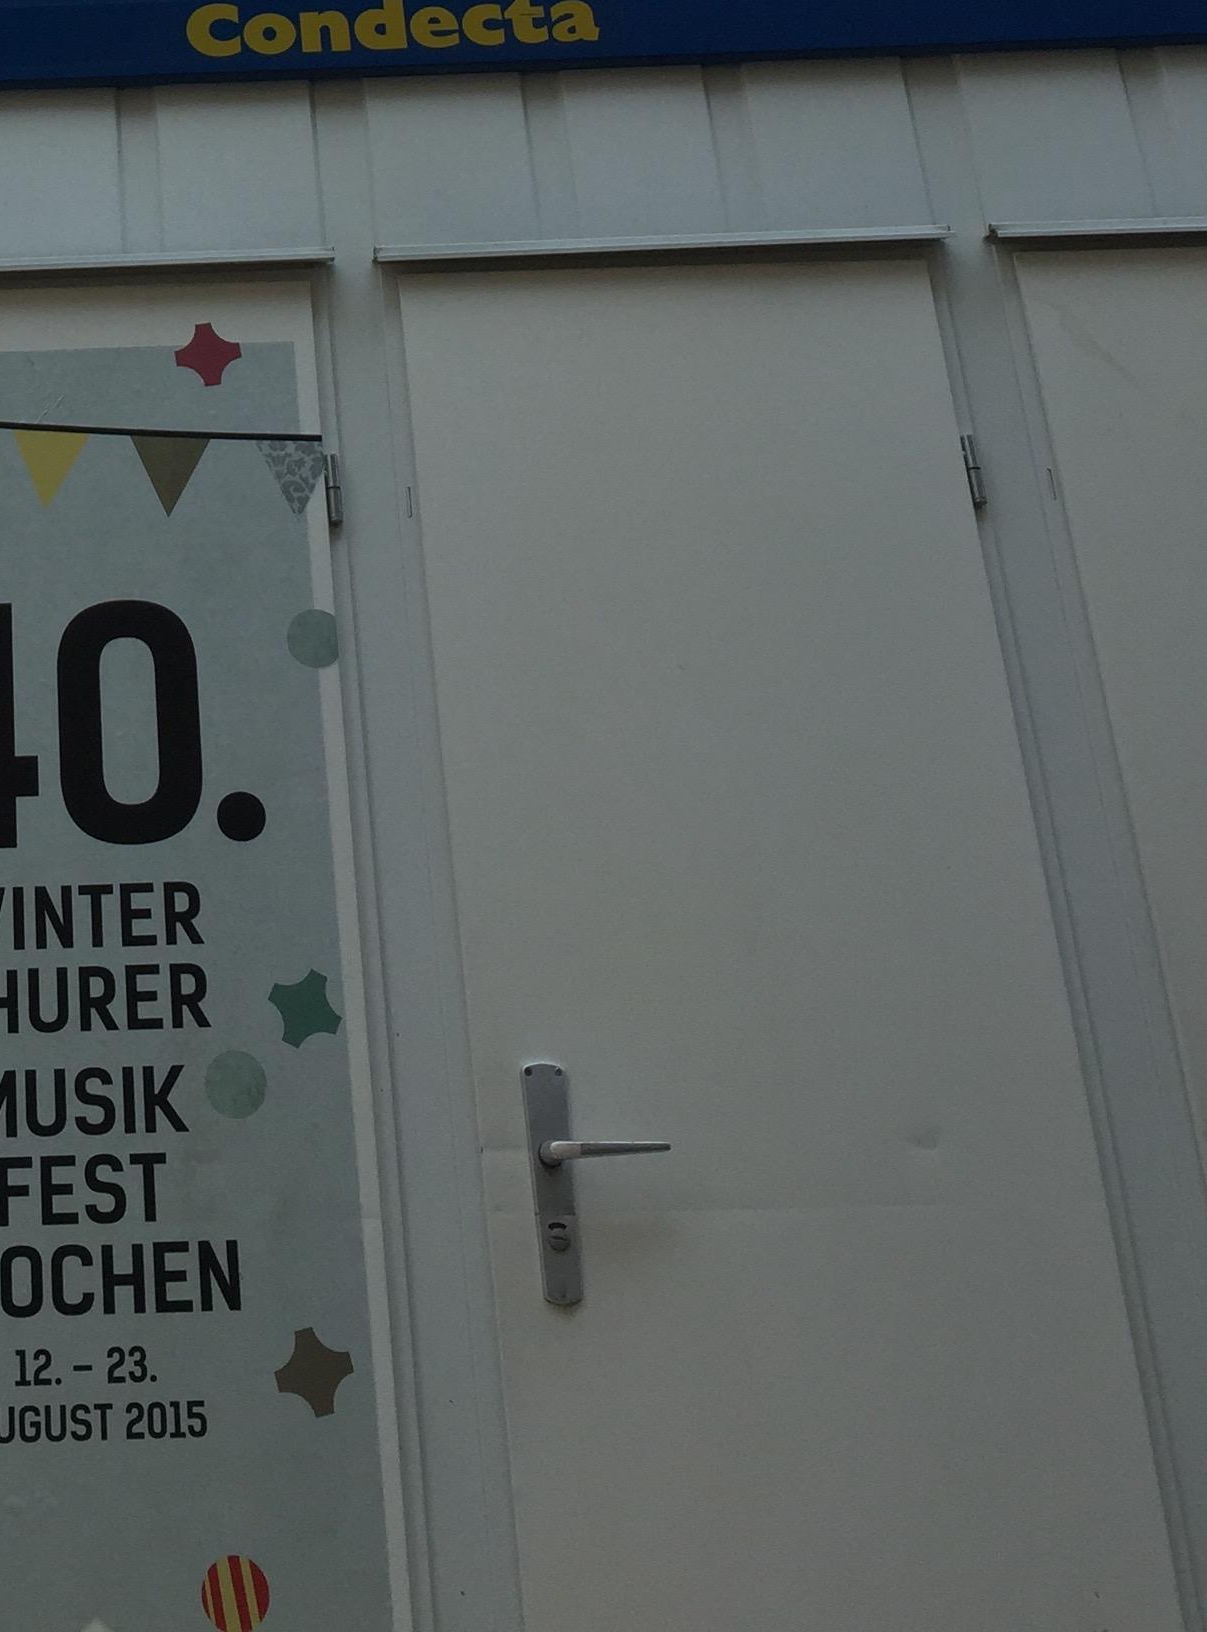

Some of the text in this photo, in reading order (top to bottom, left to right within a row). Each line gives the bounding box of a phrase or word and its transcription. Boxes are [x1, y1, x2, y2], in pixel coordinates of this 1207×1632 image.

[14, 1348, 63, 1388] 12.
[106, 1344, 158, 1385] 23.
[124, 1399, 208, 1441] 2015
